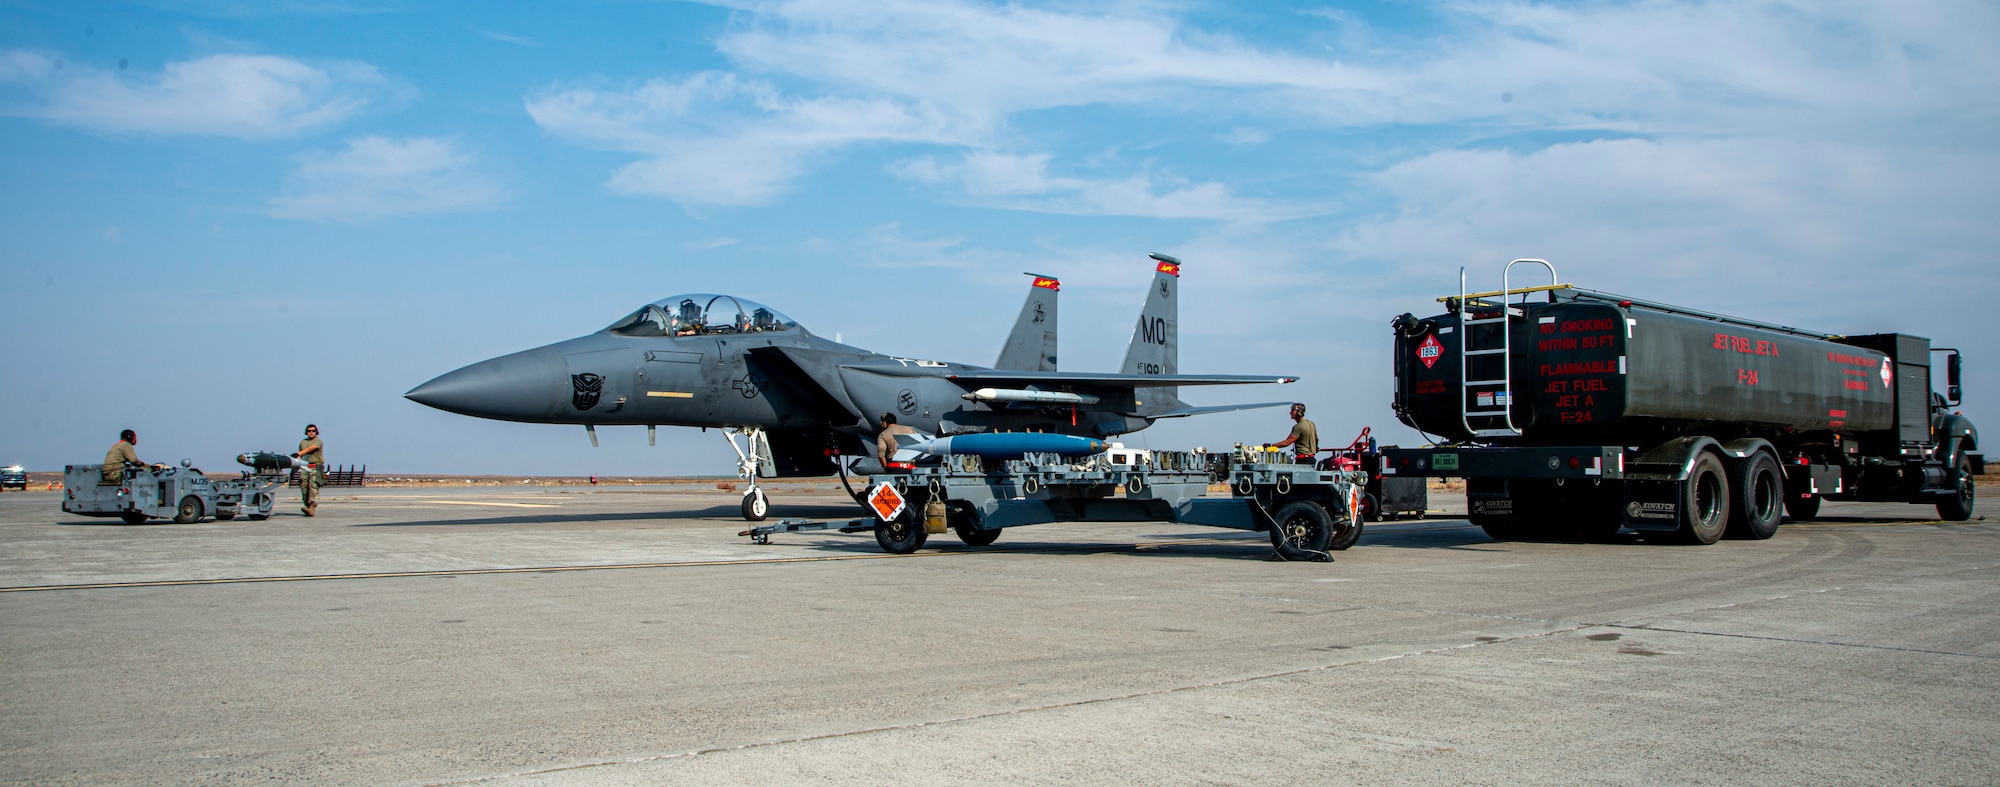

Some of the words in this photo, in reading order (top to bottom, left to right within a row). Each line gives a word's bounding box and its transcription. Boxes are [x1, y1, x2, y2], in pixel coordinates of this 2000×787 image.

[1141, 314, 1165, 345] MO
[1540, 323, 1556, 334] NO
[1560, 318, 1614, 333] SMOKING
[1538, 337, 1577, 351] WITHIN
[1581, 336, 1597, 349] 50
[1599, 335, 1615, 348] FT
[1713, 333, 1729, 350] JET
[1730, 335, 1753, 354] FUEL
[1755, 340, 1769, 356] JET
[1772, 342, 1779, 358] A
[1540, 360, 1617, 376] FLAMMABLE
[1737, 368, 1759, 386] F-24
[1545, 381, 1568, 393] JET
[1573, 379, 1608, 392] FUEL
[1555, 395, 1579, 407] JET
[1585, 394, 1595, 407] A
[1561, 411, 1592, 424] F-24
[1642, 502, 1676, 510] KOVATCH
